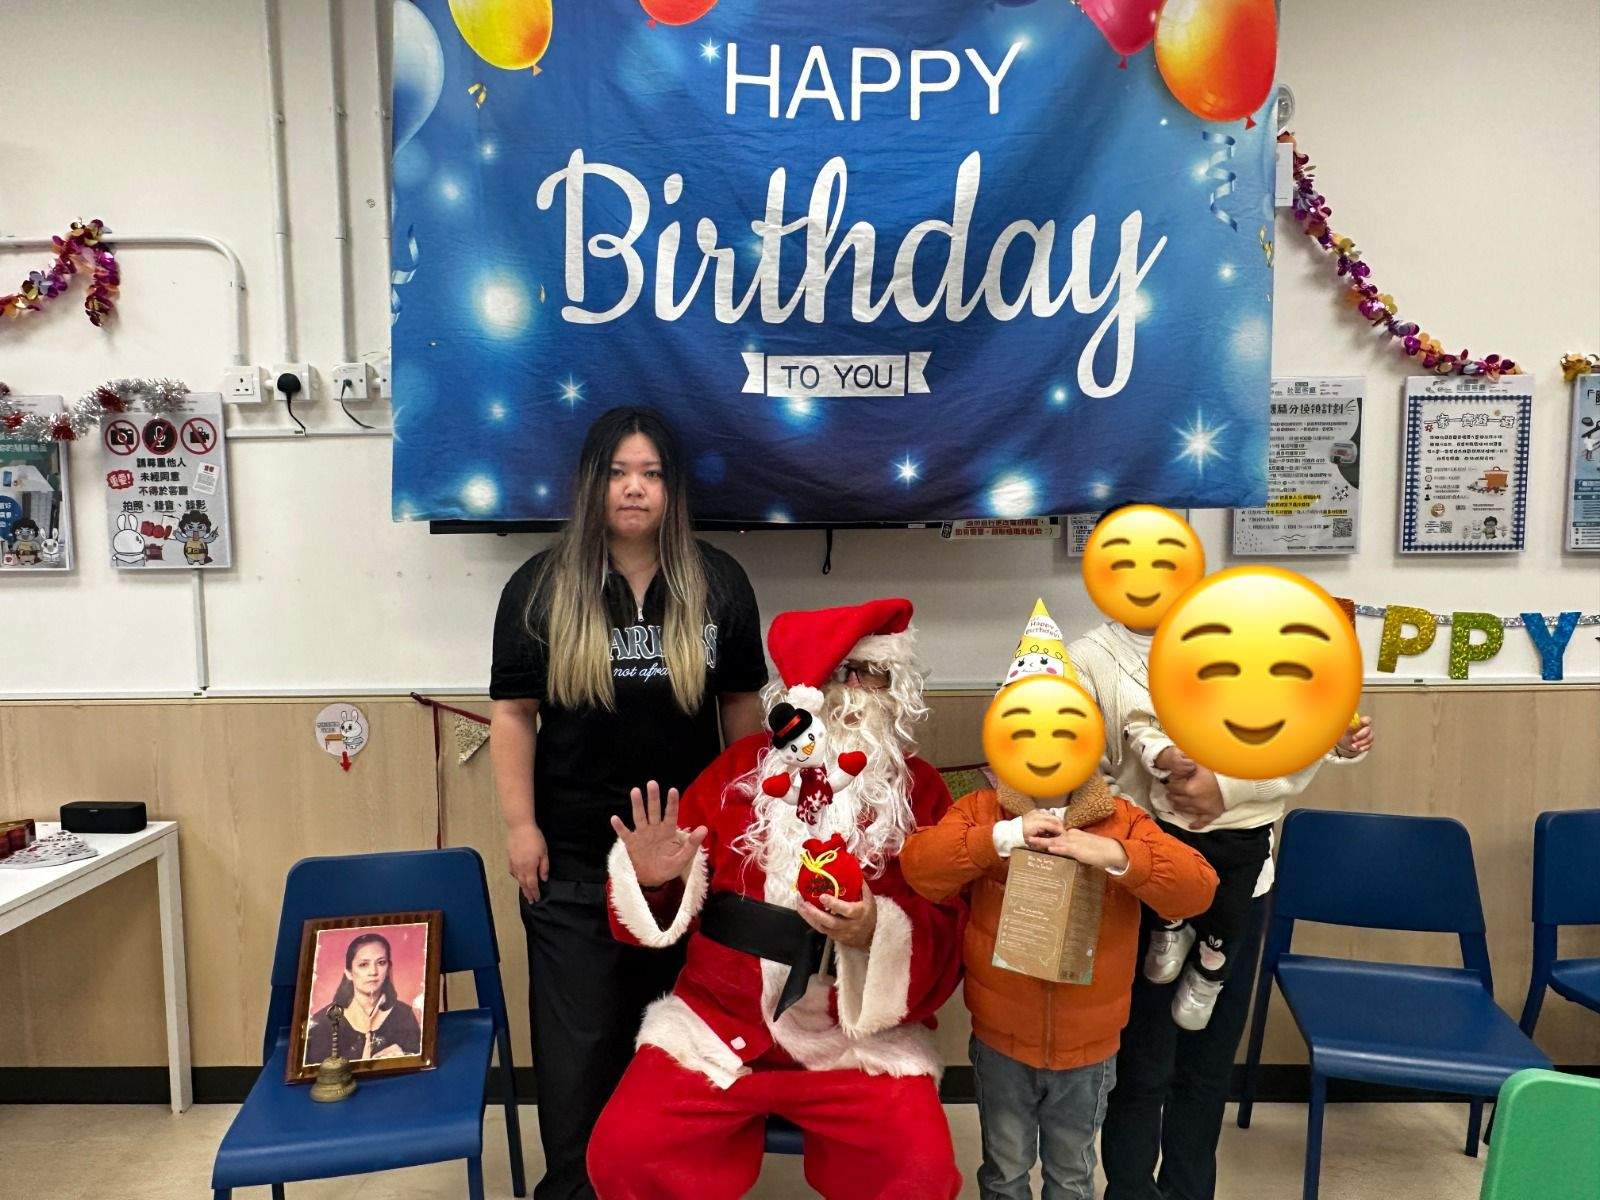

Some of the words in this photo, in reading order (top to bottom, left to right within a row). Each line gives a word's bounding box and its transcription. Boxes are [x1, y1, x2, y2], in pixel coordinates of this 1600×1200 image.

[725, 42, 1023, 122] HAPPY
[536, 148, 1168, 399] Birthday
[780, 365, 820, 389] TO
[833, 364, 893, 389] YOU
[136, 457, 187, 468] 請尊重他人
[140, 471, 180, 482] 未經同意
[138, 485, 189, 496] 不得於客廳
[1333, 597, 1582, 680] PPY
[613, 665, 637, 677] not
[638, 662, 670, 682] afra
